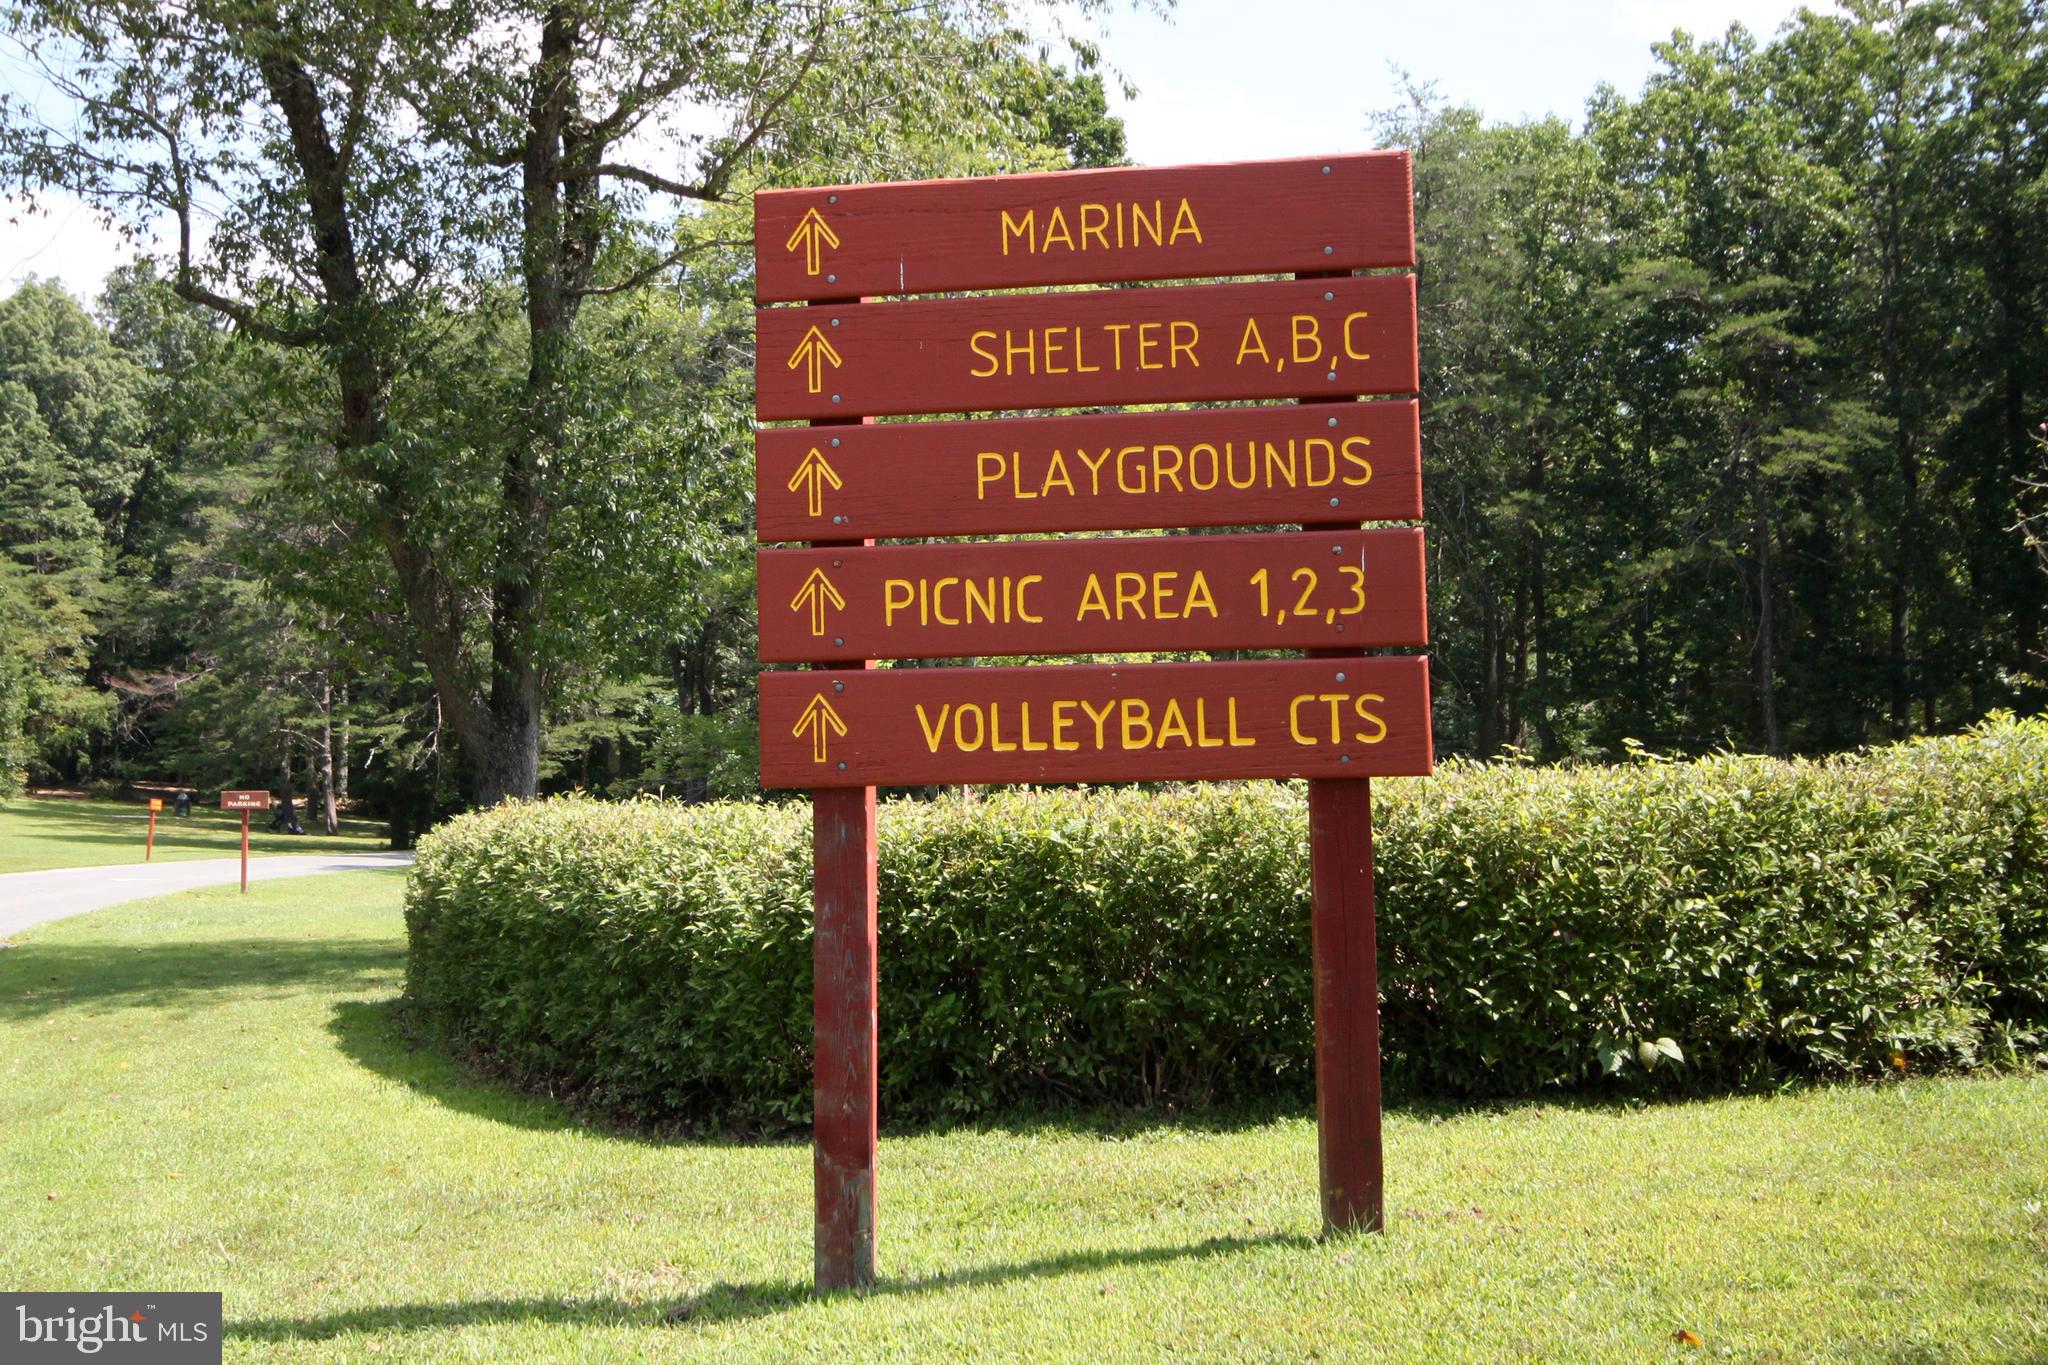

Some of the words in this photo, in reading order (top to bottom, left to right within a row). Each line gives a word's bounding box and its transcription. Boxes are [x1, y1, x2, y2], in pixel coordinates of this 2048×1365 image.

[1001, 198, 1203, 256] MARINA
[971, 320, 1200, 377] SHELTER
[1236, 311, 1371, 371] A,B,C
[976, 436, 1374, 500] PLAYGROUNDS
[884, 575, 1043, 626] PICNIC
[1077, 570, 1219, 622] AREA
[1249, 566, 1366, 626] 1,2,3
[915, 696, 1257, 753] VOLLEYBALL
[1289, 693, 1388, 746] CTS
